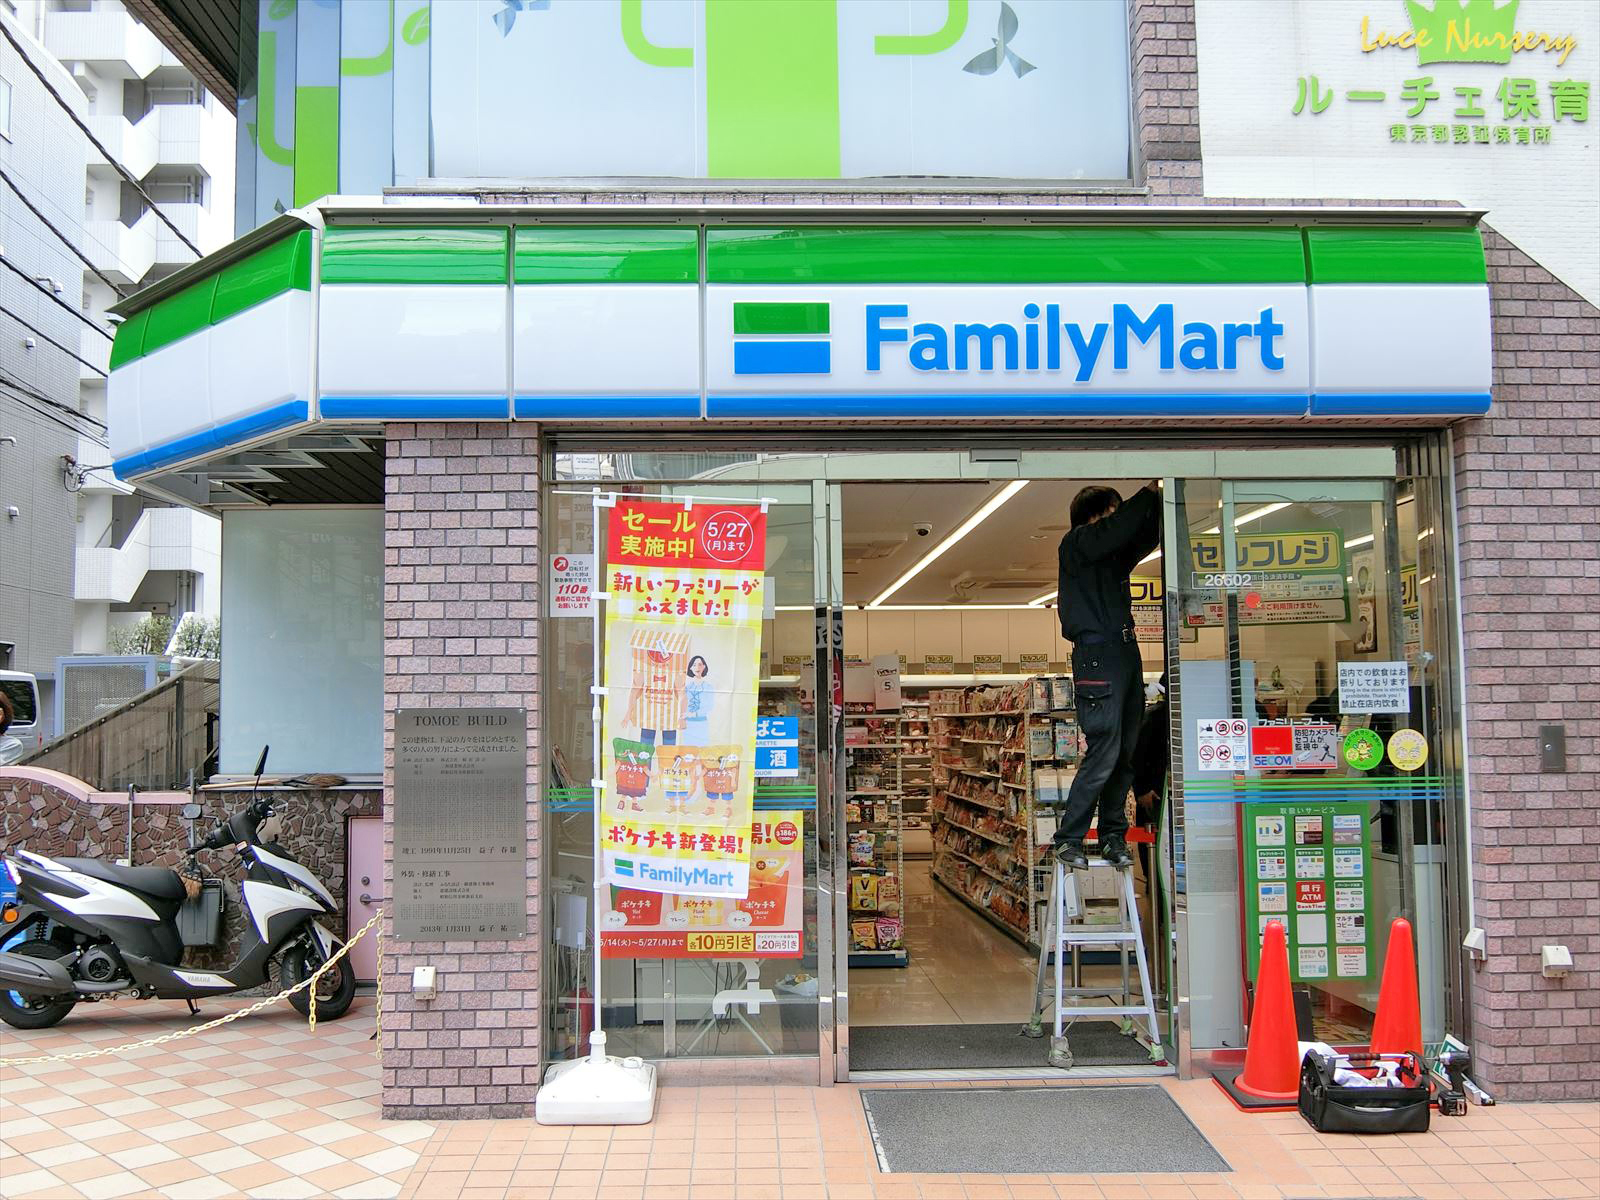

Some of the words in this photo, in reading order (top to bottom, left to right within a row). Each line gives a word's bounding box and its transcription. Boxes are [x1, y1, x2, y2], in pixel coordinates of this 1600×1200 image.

[1361, 15, 1433, 53] Luce
[1446, 17, 1578, 68] Nursery
[1292, 74, 1590, 122] ルーチェ保育
[1390, 124, 1553, 145] 東京都認証保育所
[864, 301, 1285, 384] FamilyMart
[622, 508, 697, 533] セール
[707, 522, 748, 539] 5/27
[620, 534, 695, 559] 実施中!
[558, 584, 588, 594] 110番
[613, 571, 760, 596] 新しいファミリーが
[1204, 574, 1252, 587] 26602
[638, 598, 730, 617] ふえました!
[1340, 668, 1407, 677] 店内での飲食はお
[1340, 678, 1407, 687] 断りしております
[413, 715, 460, 727] TOMOE
[467, 715, 508, 727] BUILD
[1294, 728, 1335, 736] 防犯カメラで
[770, 749, 788, 768] 酒
[1254, 755, 1292, 766] SECOM
[608, 826, 744, 855] ポケチキ新登場!
[639, 862, 735, 888] FamilyMart
[621, 899, 652, 909] ポケチキ
[683, 899, 714, 909] ポケチキ
[744, 900, 776, 909] ポケチキ
